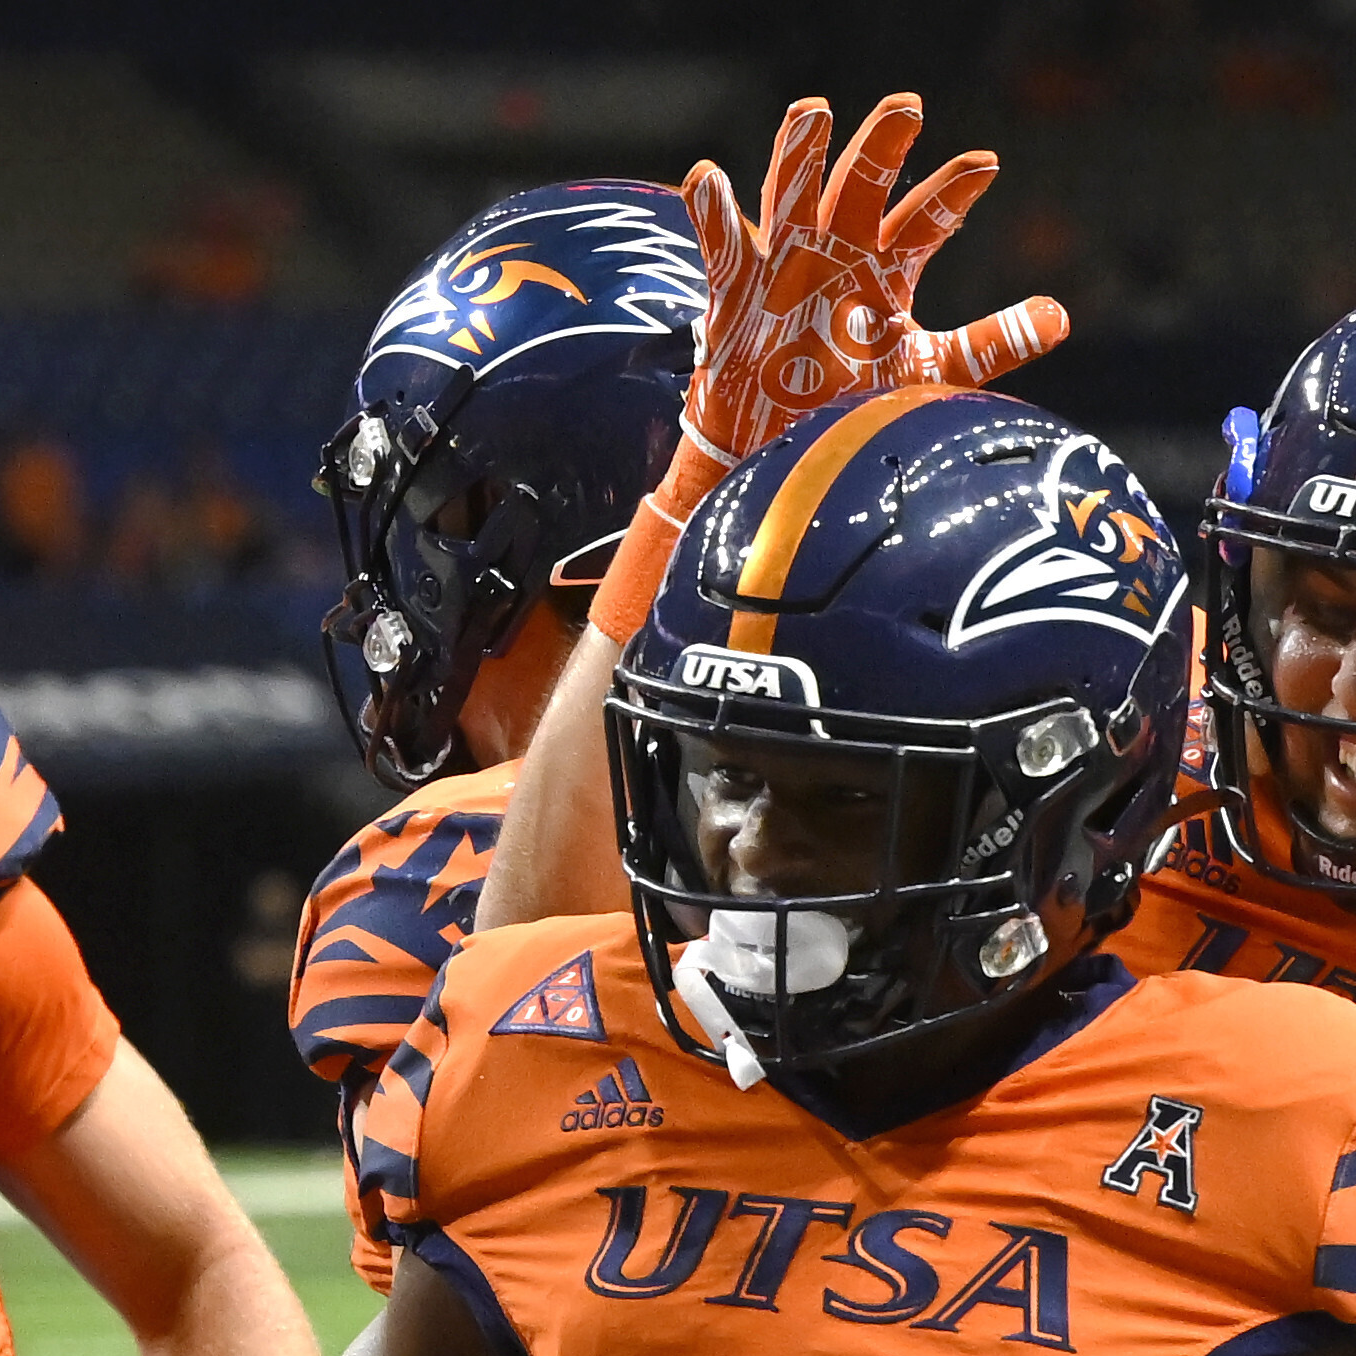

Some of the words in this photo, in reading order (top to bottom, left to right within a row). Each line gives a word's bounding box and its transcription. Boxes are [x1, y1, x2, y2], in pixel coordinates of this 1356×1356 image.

[682, 655, 782, 699] UTSA
[558, 972, 576, 983] 2
[524, 1006, 536, 1019] 1
[566, 1007, 583, 1022] 0
[560, 1103, 664, 1132] adidas
[1104, 1095, 1205, 1213] A
[585, 1186, 1077, 1353] UTSA
